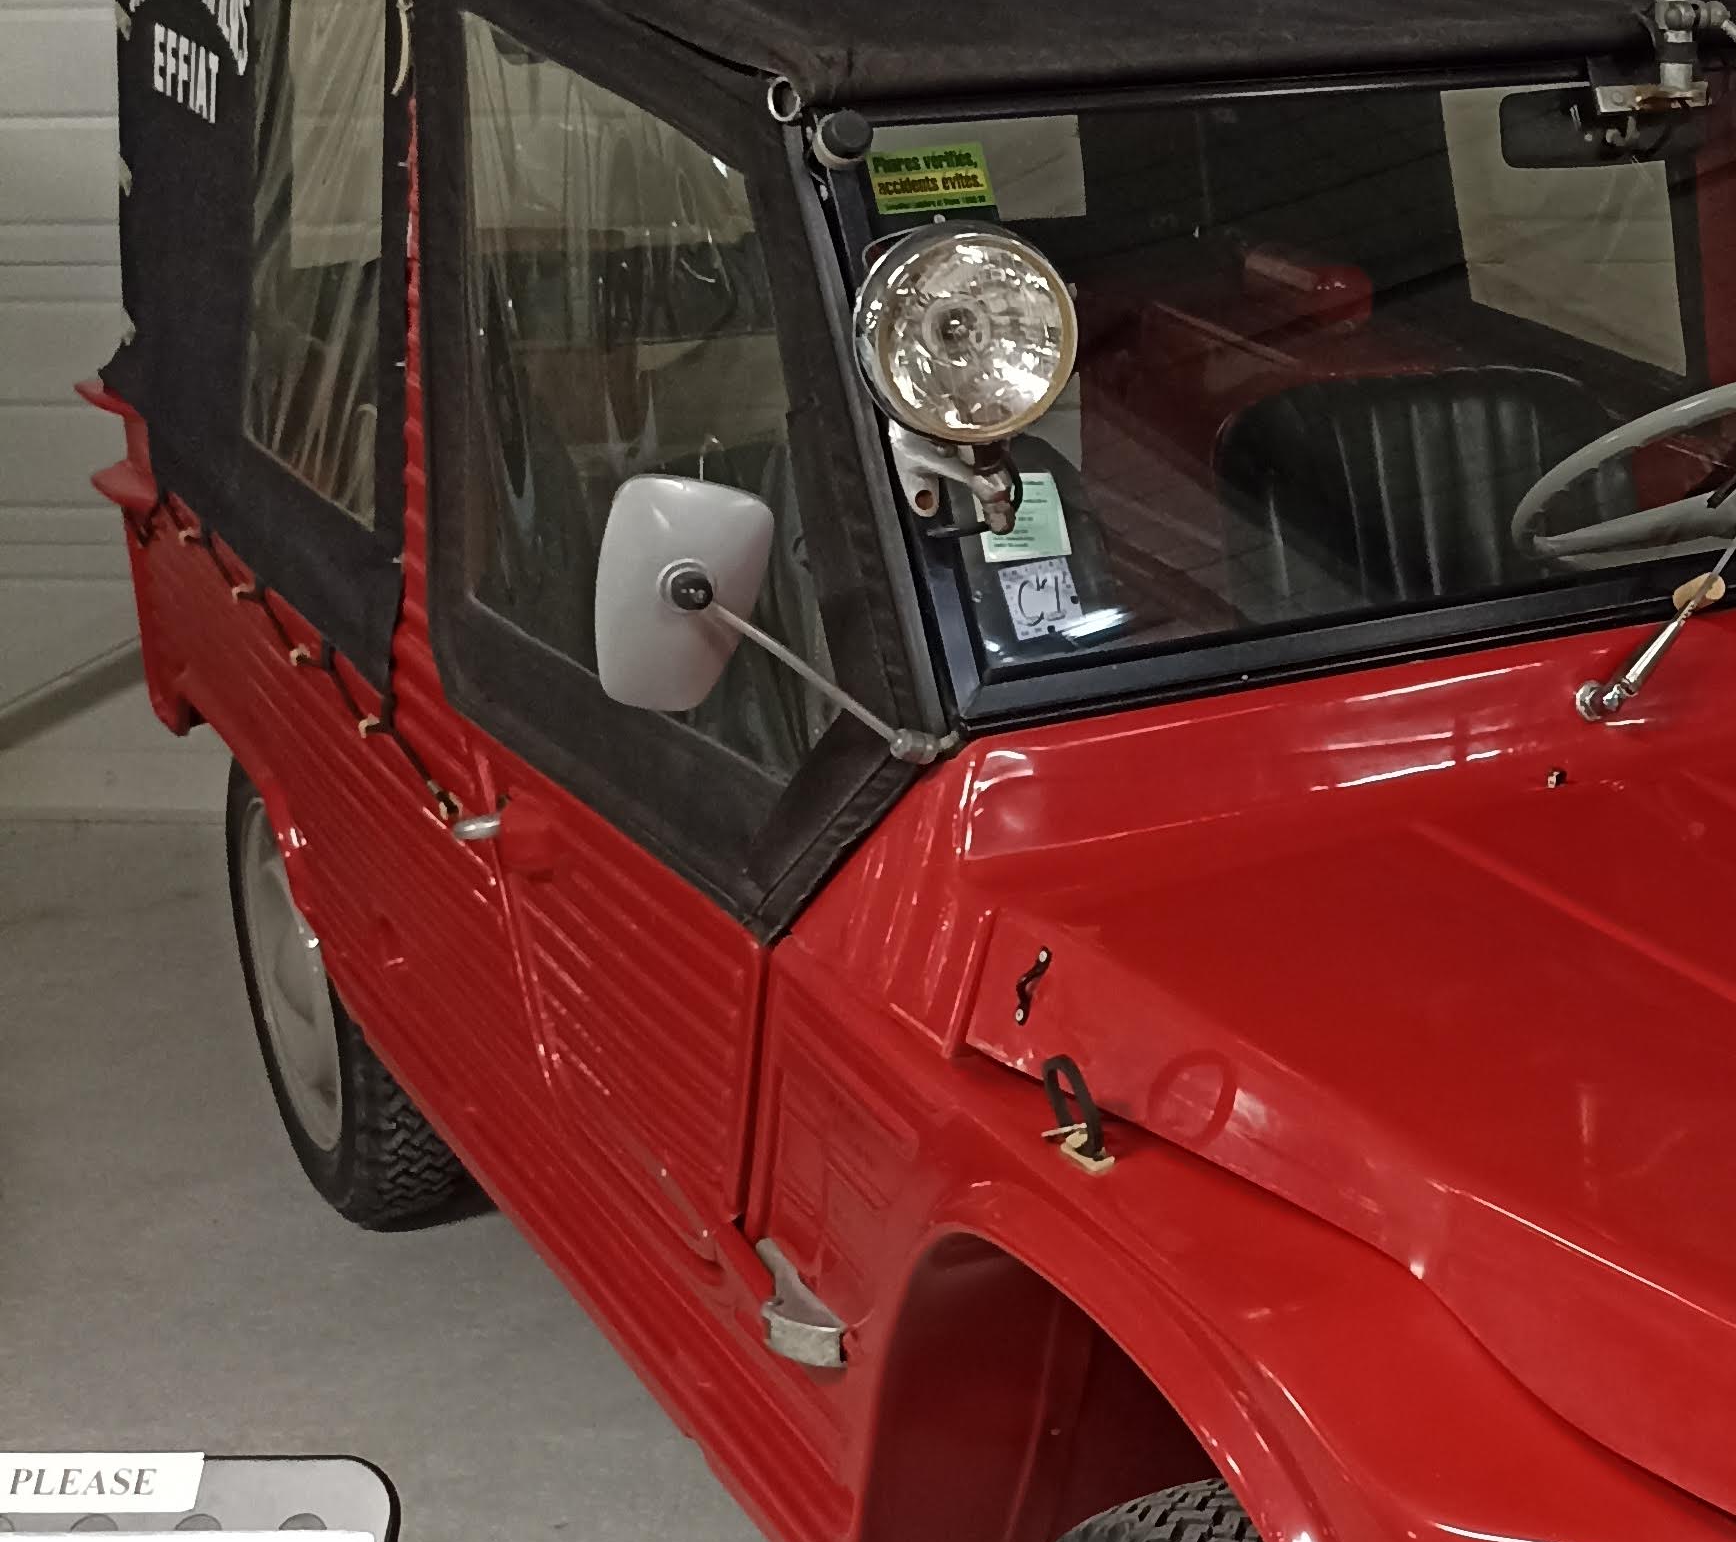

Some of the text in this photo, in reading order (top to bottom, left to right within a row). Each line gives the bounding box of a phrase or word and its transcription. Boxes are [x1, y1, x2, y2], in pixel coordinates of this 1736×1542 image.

[152, 22, 219, 124] EFFIAT
[878, 175, 939, 195] accidents
[9, 1468, 158, 1496] PLEASE
